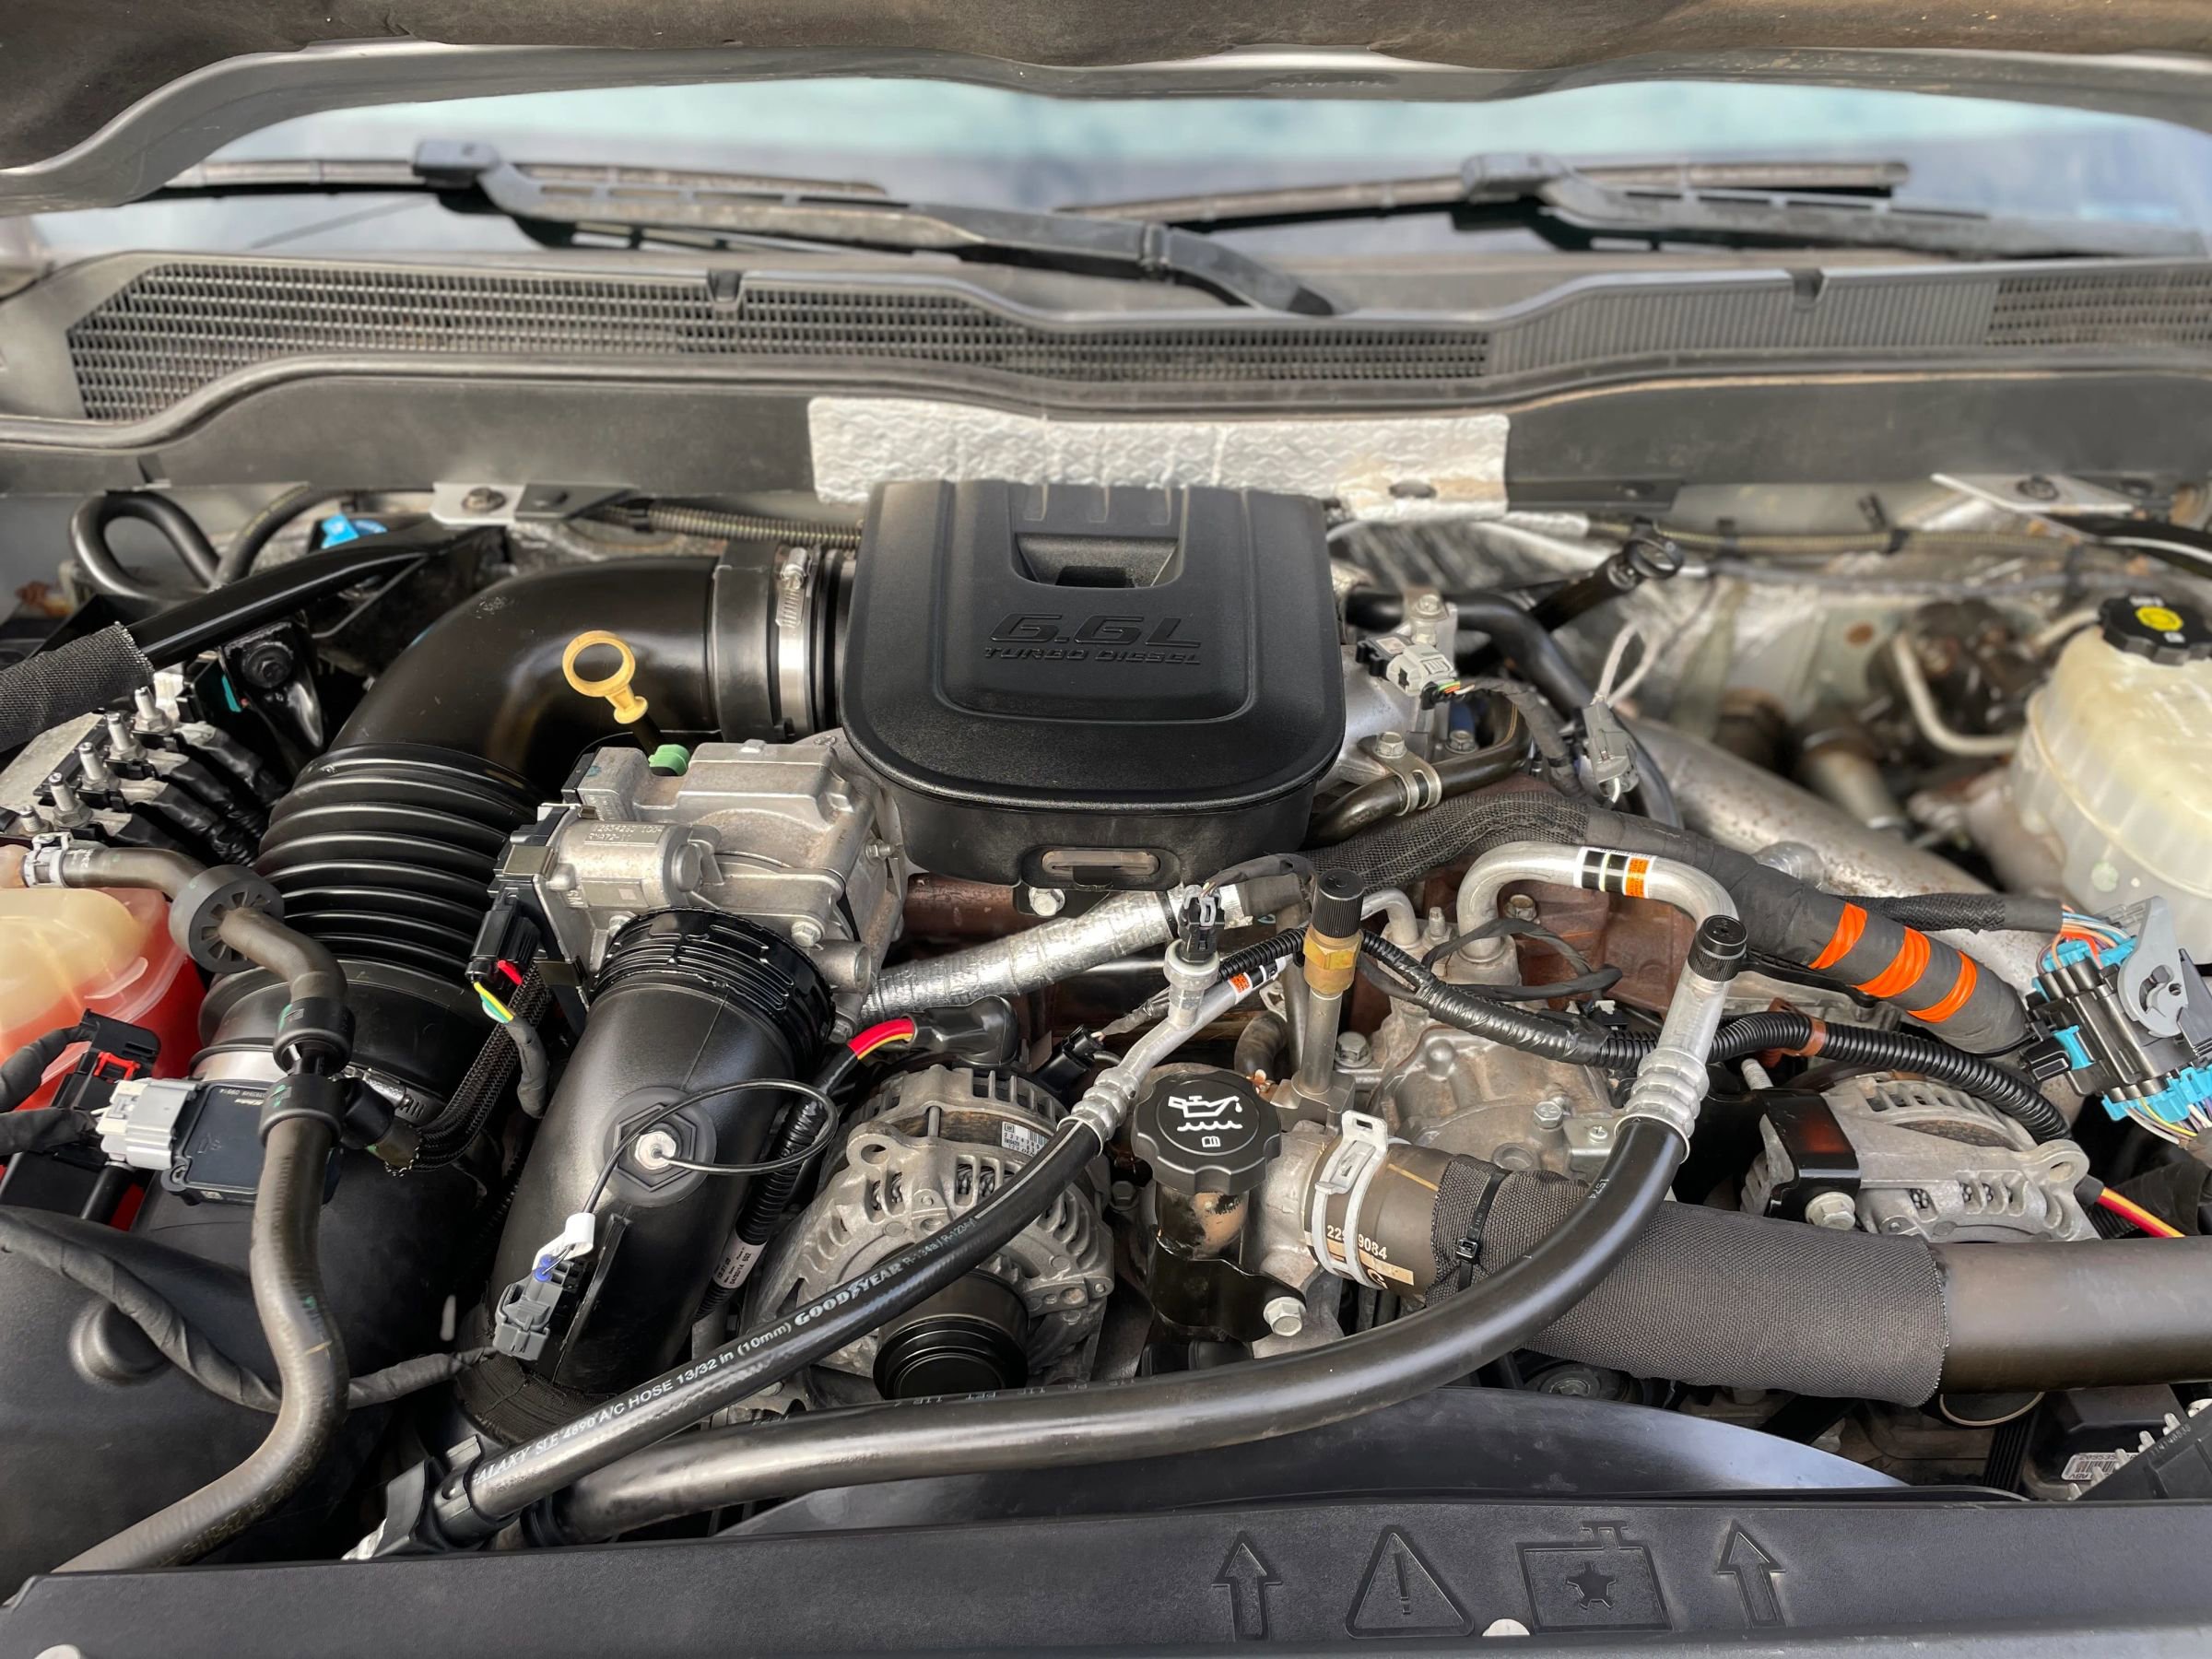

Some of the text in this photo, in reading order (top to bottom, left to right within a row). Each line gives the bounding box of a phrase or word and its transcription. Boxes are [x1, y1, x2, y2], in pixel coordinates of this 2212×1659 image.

[989, 613, 1202, 648] 6.6L
[984, 646, 1201, 665] TURBO DIESEL
[1327, 1224, 1387, 1260] 229084
[599, 1403, 625, 1423] A/C
[629, 1379, 674, 1409] HOSE
[677, 1359, 718, 1385] 13/32
[719, 1350, 735, 1365] in
[737, 1323, 792, 1357] (10mm)
[794, 1262, 904, 1326] GOODYEAR
